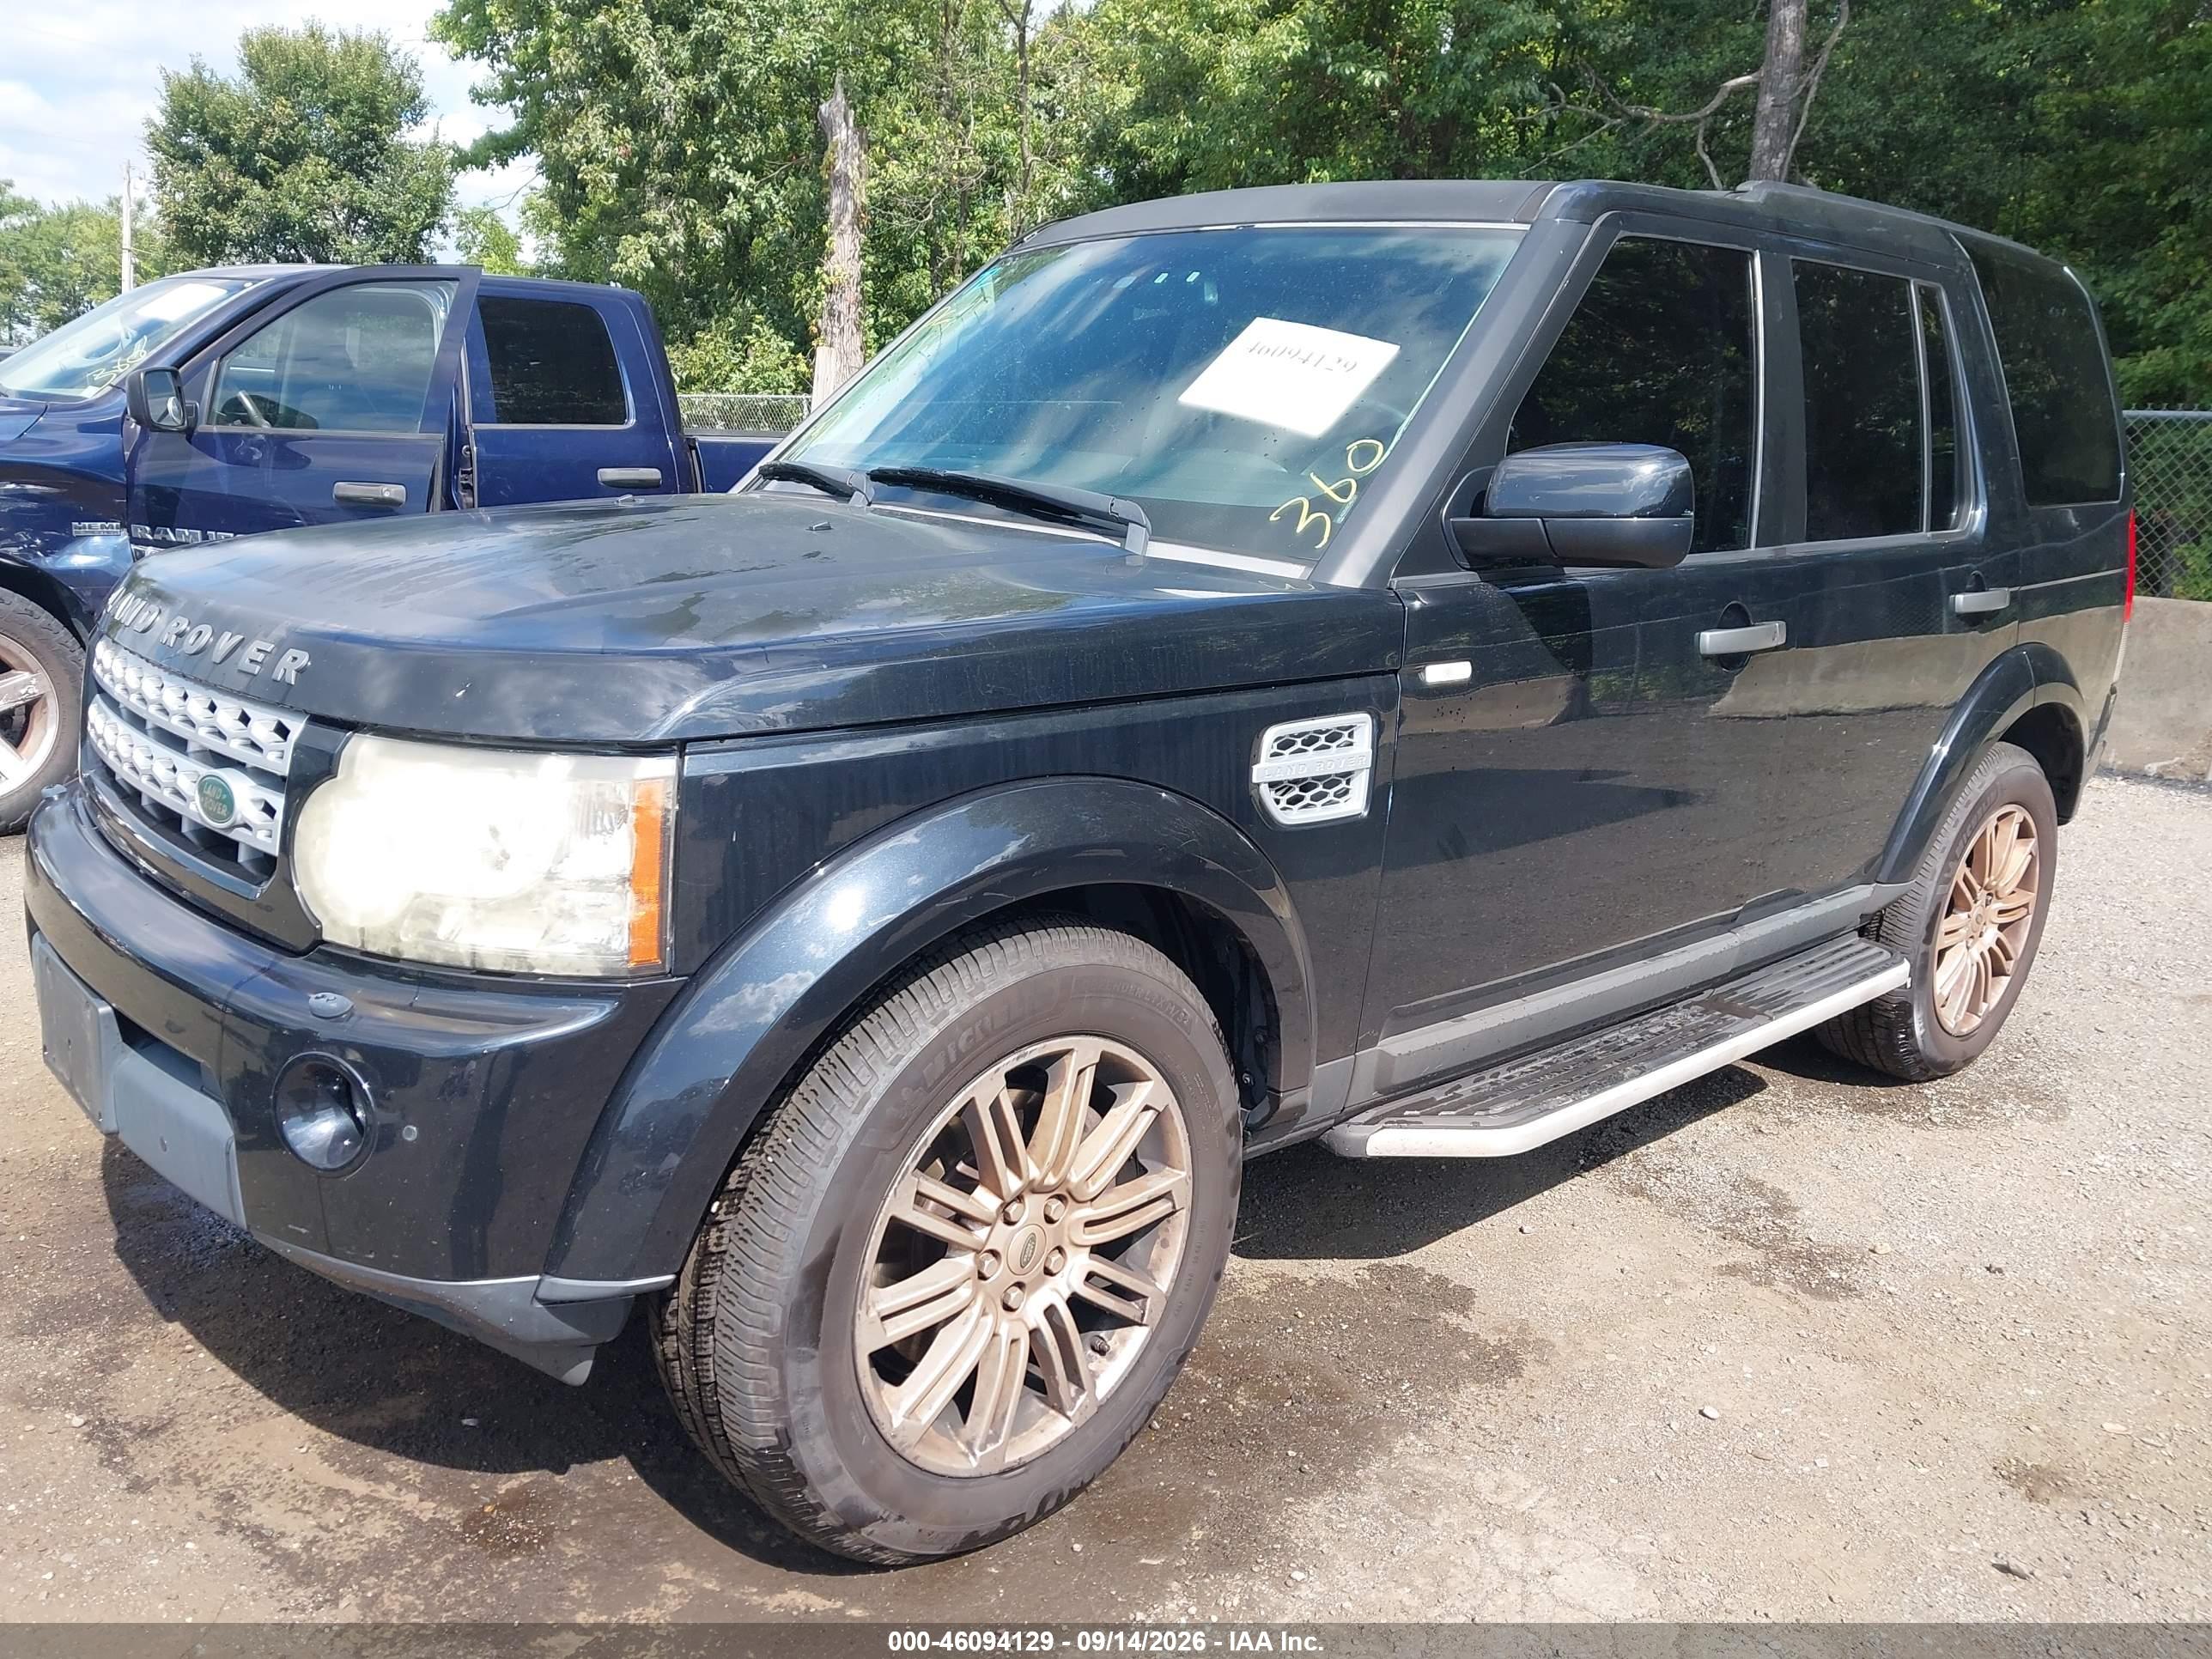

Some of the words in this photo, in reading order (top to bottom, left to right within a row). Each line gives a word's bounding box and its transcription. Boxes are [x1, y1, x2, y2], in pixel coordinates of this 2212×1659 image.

[1269, 439, 1384, 549] 360
[72, 521, 120, 532] HEMI
[131, 524, 202, 543] RAM
[160, 615, 311, 685] ROVER
[1264, 763, 1308, 778] LAND
[1315, 755, 1367, 772] ROVER
